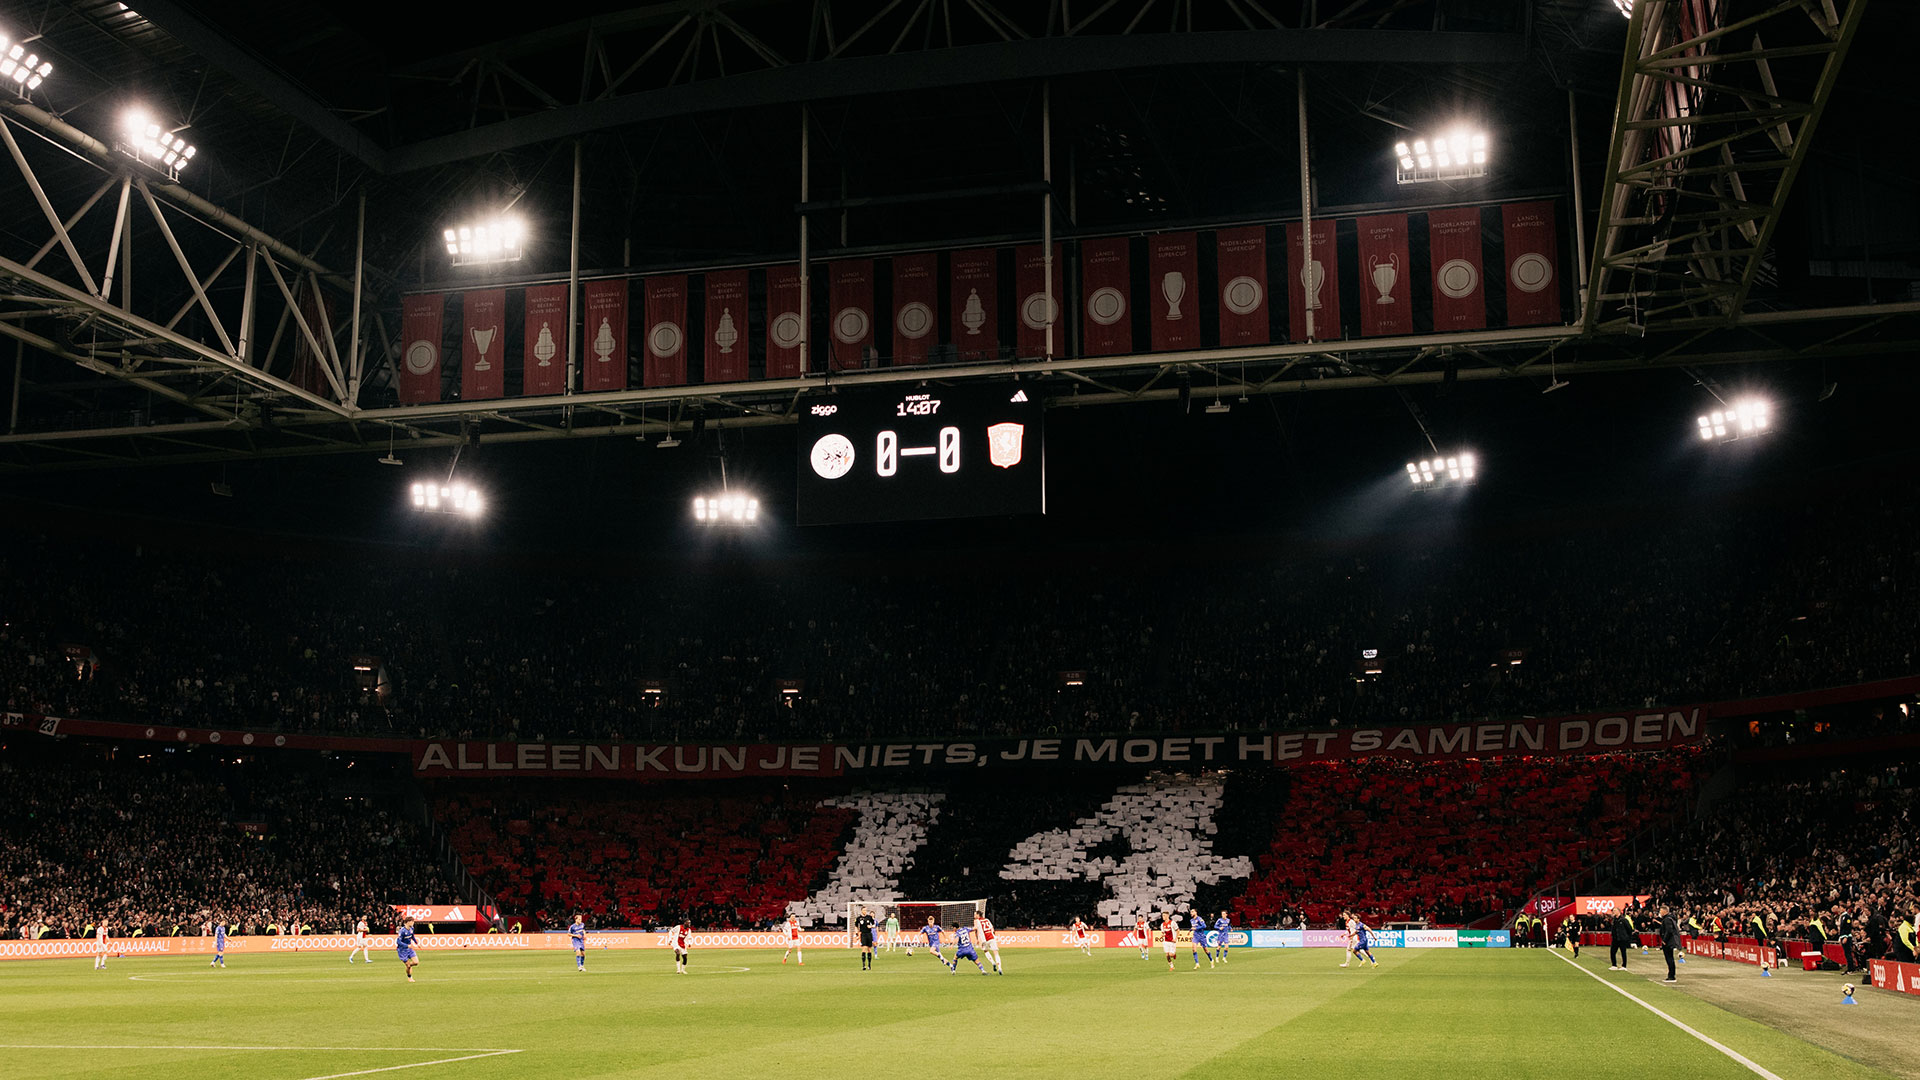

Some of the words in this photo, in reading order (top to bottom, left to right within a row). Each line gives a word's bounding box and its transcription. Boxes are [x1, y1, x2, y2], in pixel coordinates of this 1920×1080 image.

[1432, 220, 1476, 228] NEDERLANDSE
[905, 394, 931, 402] HUBLOT
[811, 404, 838, 416] ziggo
[896, 400, 941, 416] 14:07
[417, 742, 620, 771] ALLEEN
[635, 745, 747, 772] KUN
[758, 746, 820, 770] JE
[833, 743, 988, 770] NIETS,
[1000, 739, 1062, 761] JE
[1074, 737, 1225, 763] MOET
[1238, 732, 1338, 761] HET
[1349, 722, 1546, 755] SAMEN
[1557, 708, 1701, 751] DOEN
[1586, 897, 1615, 914] ziggo
[1406, 935, 1456, 943] OLYMPIA
